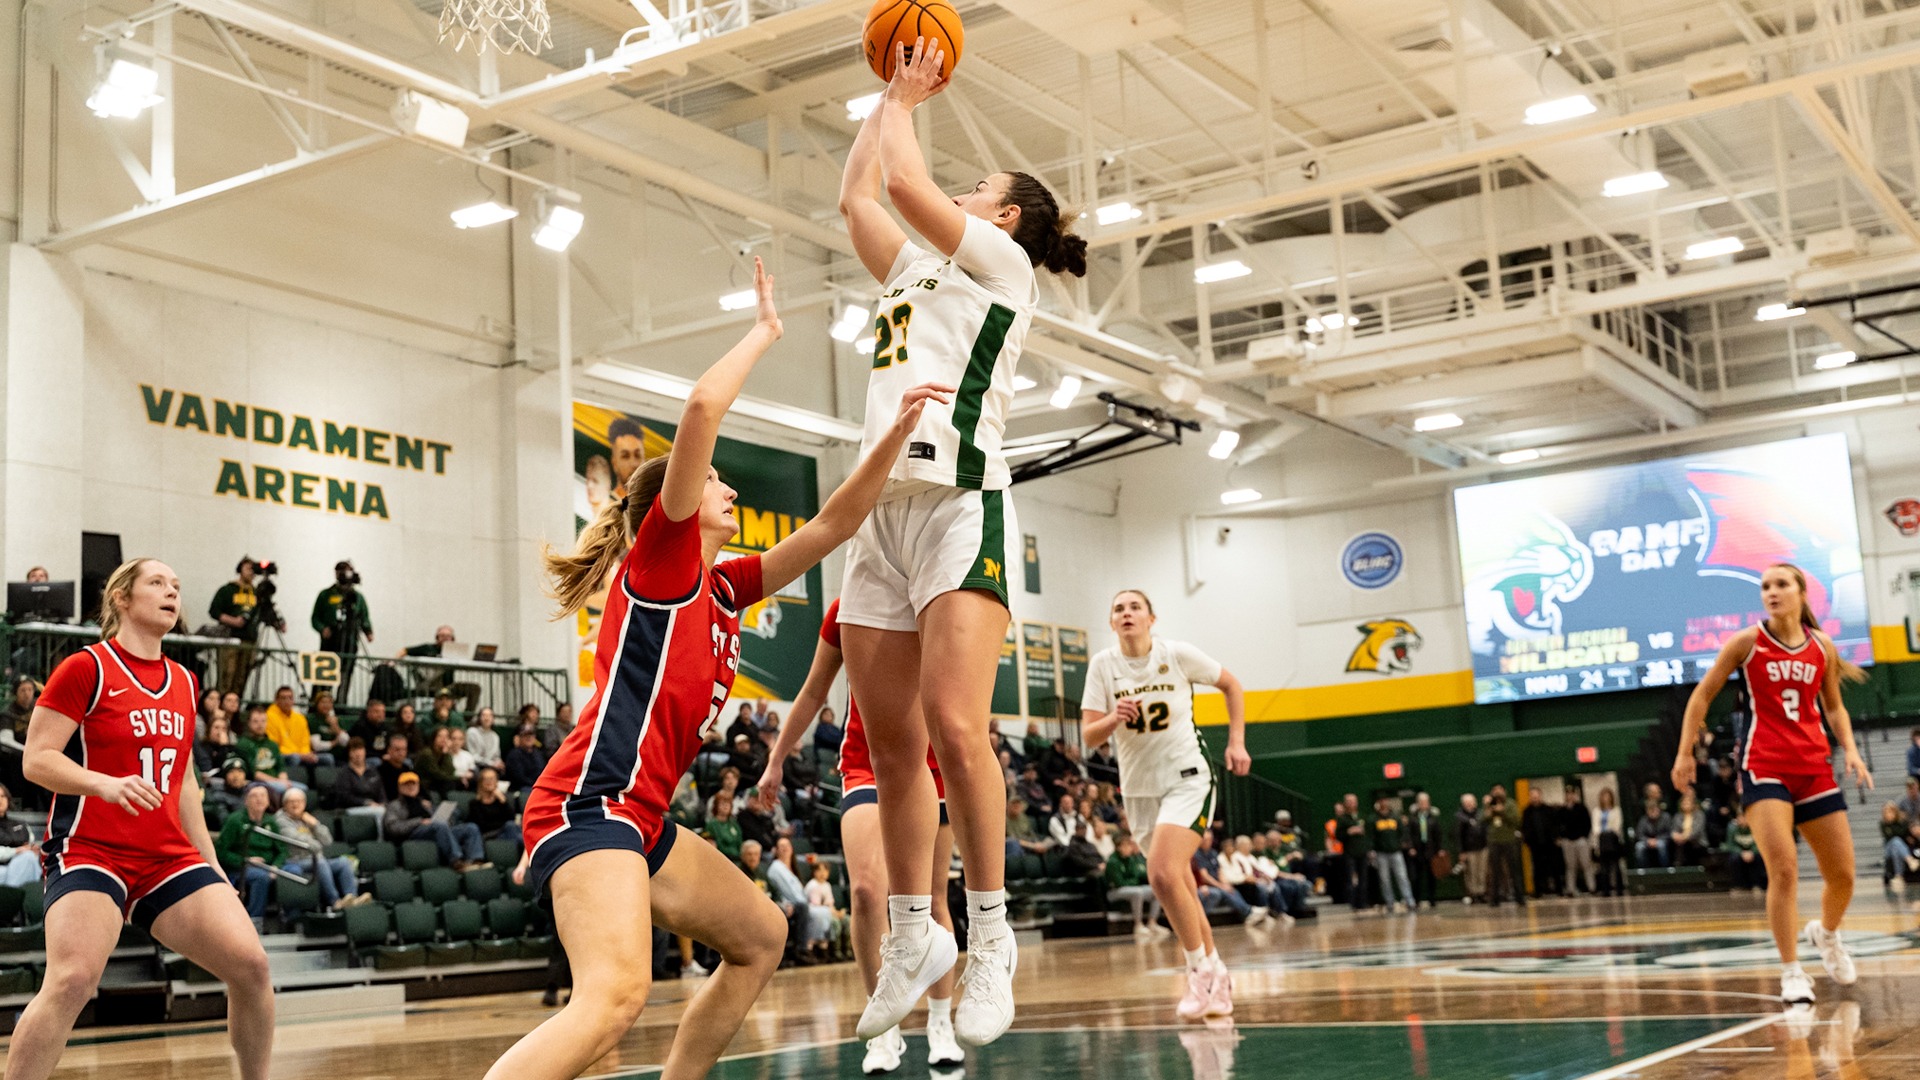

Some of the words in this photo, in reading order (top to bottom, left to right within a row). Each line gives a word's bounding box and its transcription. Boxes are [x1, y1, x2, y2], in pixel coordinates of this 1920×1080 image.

[873, 300, 914, 371] 23
[138, 383, 454, 476] VANDAMENT
[214, 457, 391, 521] ARENA
[983, 557, 1002, 583] N
[1620, 546, 1682, 573] DAY
[302, 653, 338, 682] 12
[1500, 641, 1640, 674] WILDCATS
[1765, 660, 1818, 685] SVSU
[1114, 684, 1175, 699] WILDCATS
[1579, 670, 1605, 690] 24
[1125, 700, 1170, 734] 42
[1781, 688, 1801, 723] 2
[128, 707, 186, 739] SVSU
[138, 746, 178, 795] 12
